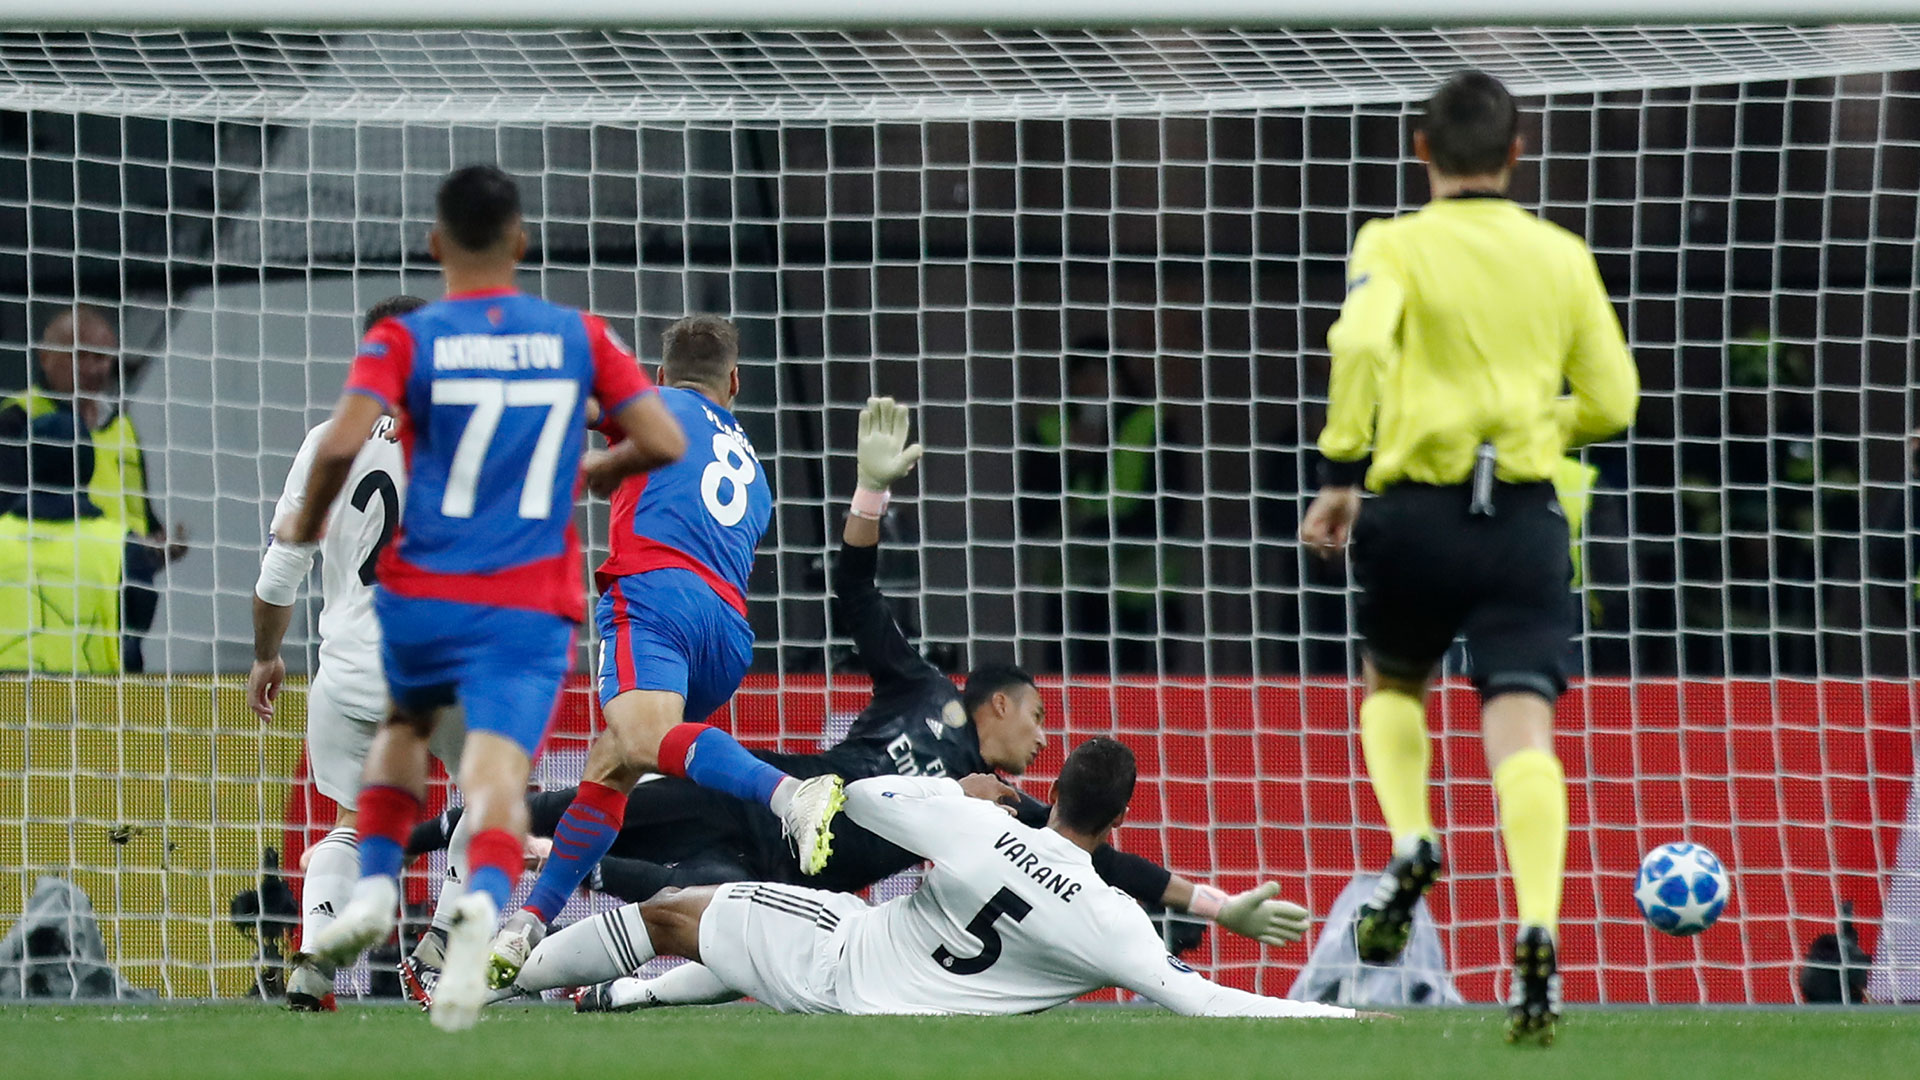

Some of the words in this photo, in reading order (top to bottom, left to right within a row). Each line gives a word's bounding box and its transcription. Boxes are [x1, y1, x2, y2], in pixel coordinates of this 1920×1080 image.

[434, 334, 563, 370] AKHMETOV
[431, 378, 579, 519] 77
[701, 433, 756, 527] 8
[994, 832, 1082, 903] VARANE
[931, 886, 1033, 975] 5
